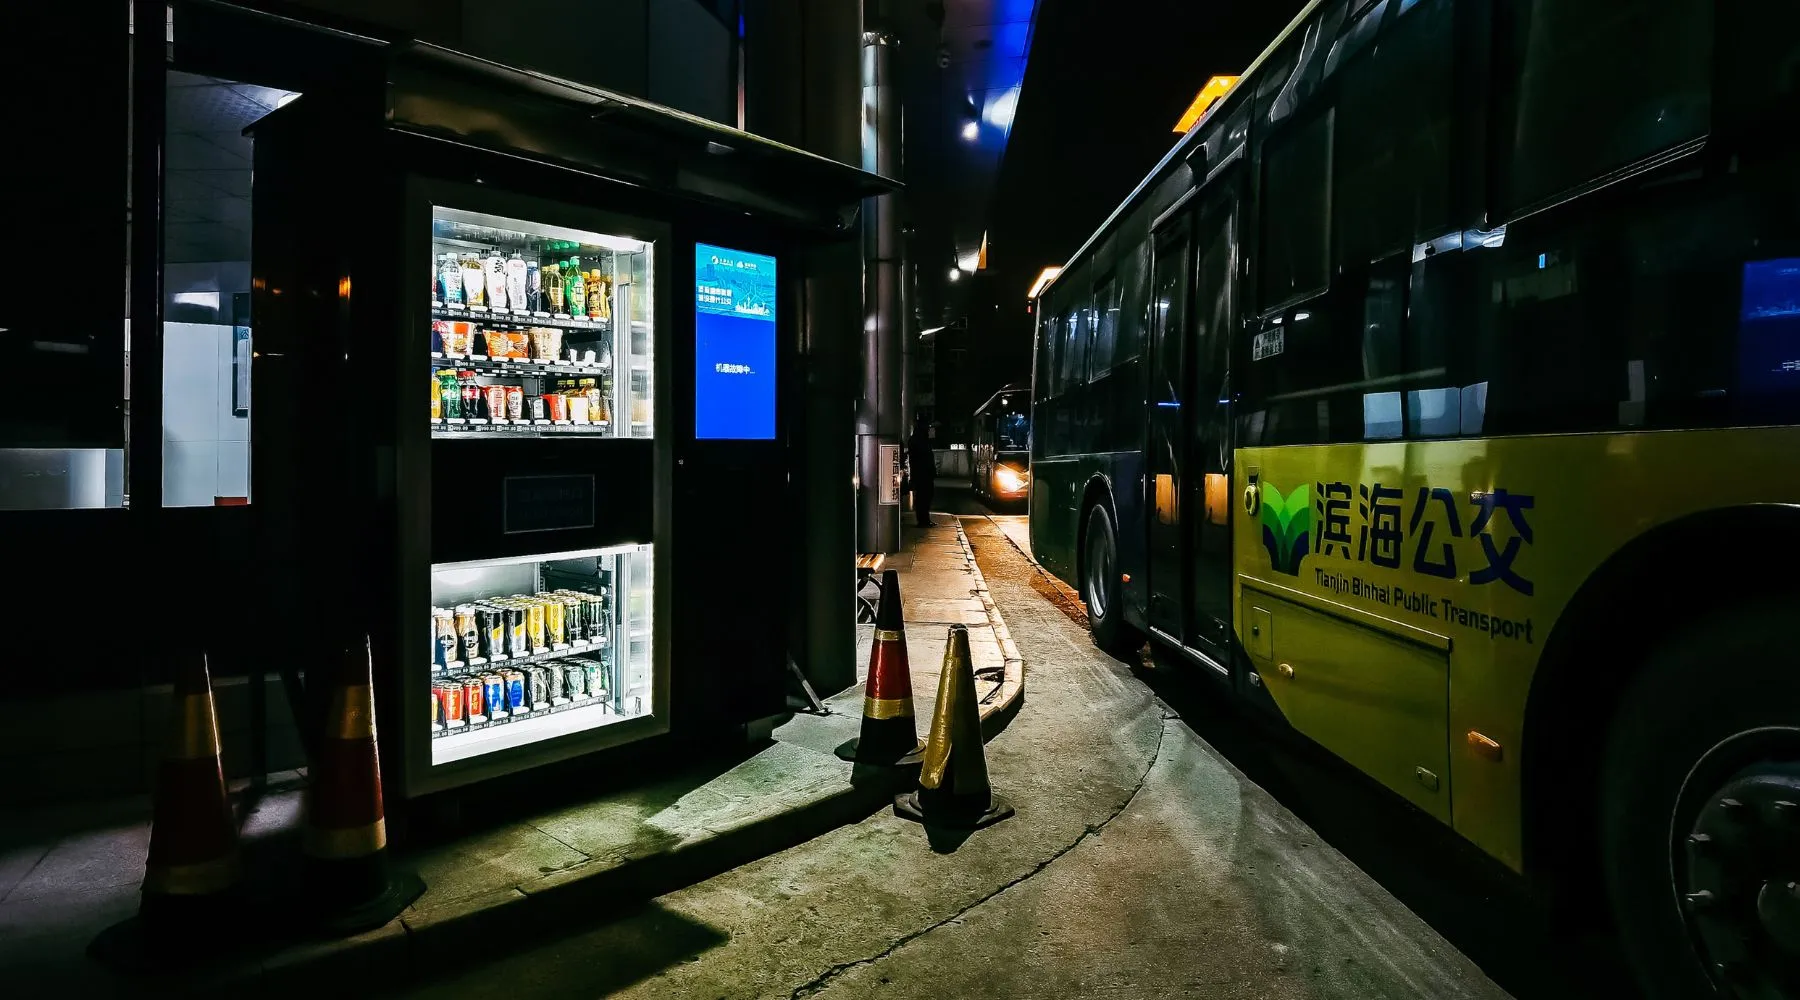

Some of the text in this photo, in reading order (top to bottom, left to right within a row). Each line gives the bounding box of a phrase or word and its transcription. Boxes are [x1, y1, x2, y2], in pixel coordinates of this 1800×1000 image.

[1314, 480, 1535, 597] 滨海公交
[1315, 567, 1534, 644] Tianjin Binhai Public Transport
